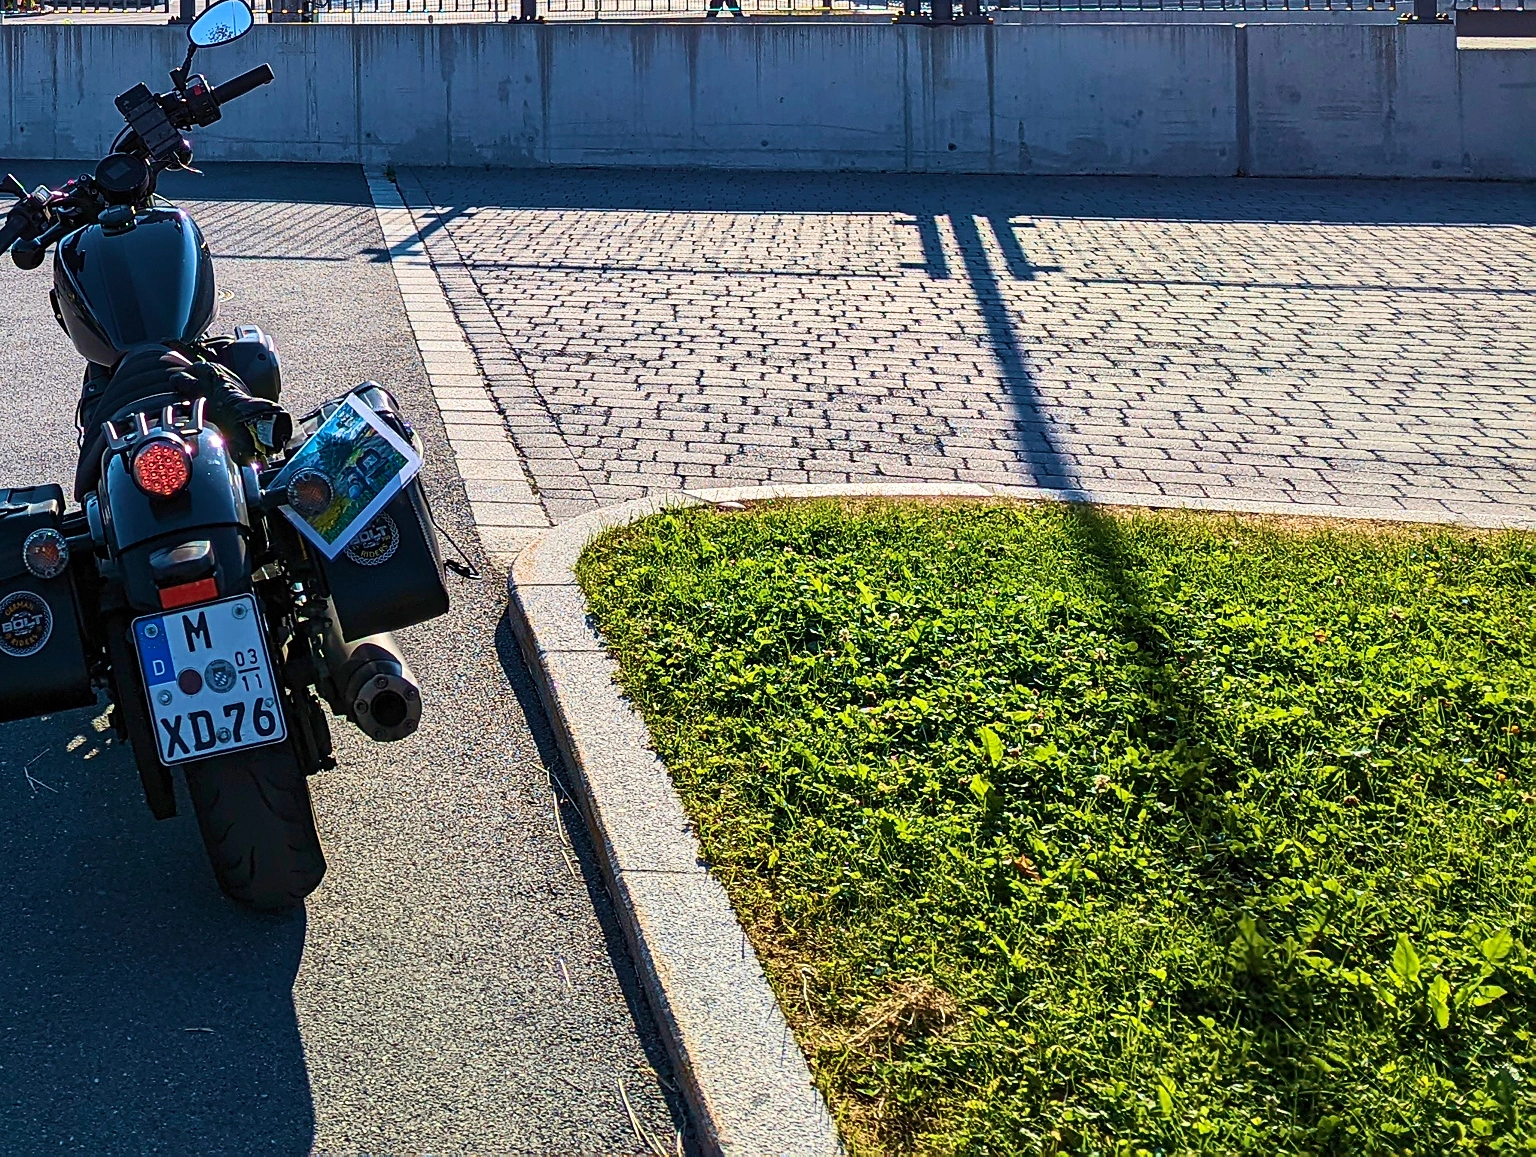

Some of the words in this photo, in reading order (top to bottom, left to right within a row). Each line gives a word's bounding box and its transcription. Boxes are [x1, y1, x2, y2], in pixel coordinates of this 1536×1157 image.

[2, 614, 43, 633] BOLT
[182, 611, 213, 653] M
[234, 648, 259, 667] 03
[152, 659, 166, 676] D
[241, 673, 263, 692] 11
